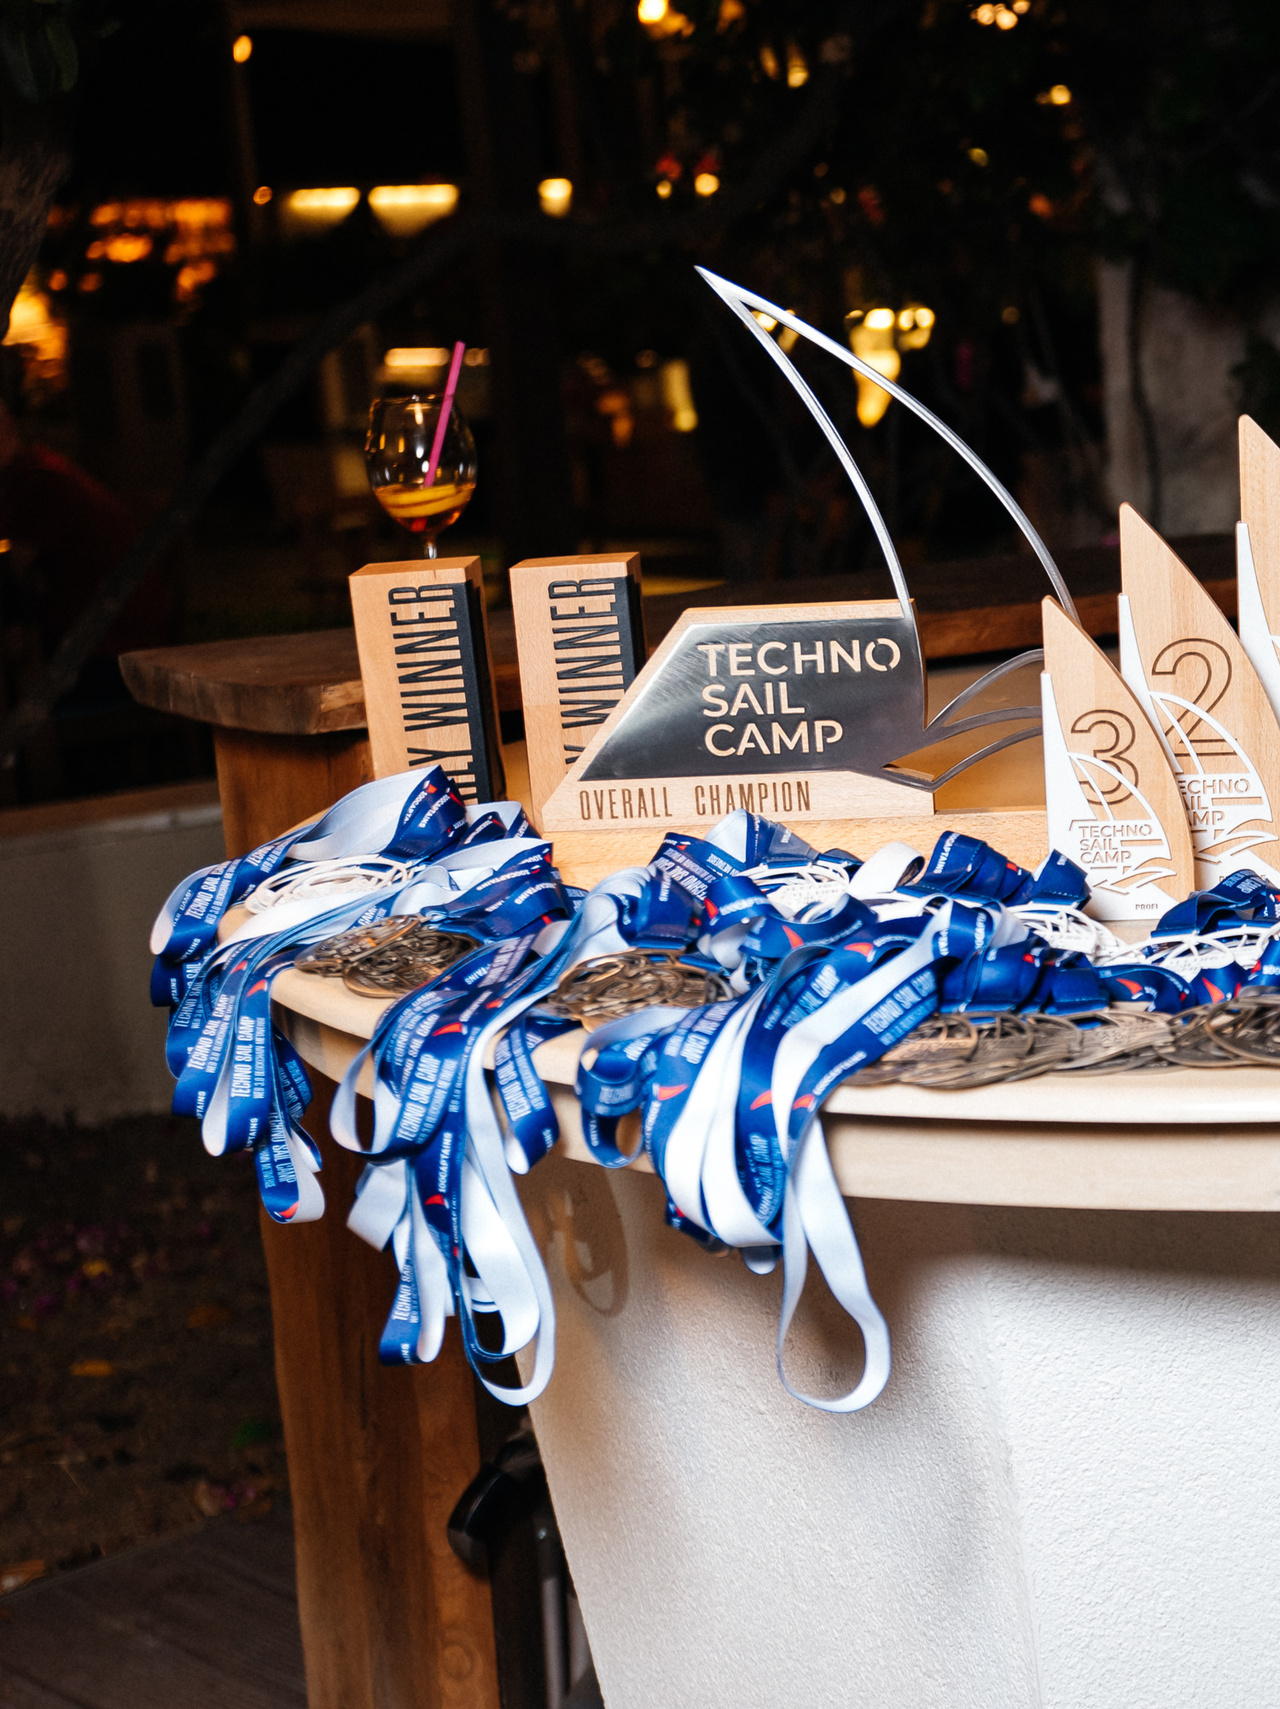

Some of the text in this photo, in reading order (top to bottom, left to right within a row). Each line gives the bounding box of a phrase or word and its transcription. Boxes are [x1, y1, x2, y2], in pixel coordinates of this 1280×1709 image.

[388, 582, 468, 732] WINNER
[548, 577, 626, 729] WINNER
[697, 637, 901, 677] TECHNO
[703, 681, 805, 717] SAIL
[1151, 637, 1233, 757] 2
[704, 719, 843, 757] CAMP
[1070, 709, 1139, 806] 3
[579, 780, 811, 820] OVERALL CHAMPION
[1178, 778, 1250, 795] ECHNO
[1078, 823, 1152, 838] TECHNO
[1080, 838, 1118, 851] SAIL
[1080, 850, 1132, 864] CAMP
[184, 877, 220, 920] TECHNO SAIL
[1135, 903, 1159, 911] PROFI
[174, 999, 198, 1028] TECHNO
[861, 985, 921, 1035] TECHNO SAIL
[187, 994, 230, 1070] TECHNO SAIL CAMP
[205, 1062, 218, 1074] WEB
[231, 1015, 256, 1098] TECHNO SAIL CAMP
[252, 1045, 265, 1099] WEB 3.0 BLOCKCHAIN
[397, 1053, 442, 1142] TECHNO SAIL CAMP
[497, 1060, 532, 1122] TECHNO SAIL
[438, 1133, 453, 1193] 100CAPTAINS
[393, 1284, 412, 1322] TECHNO
